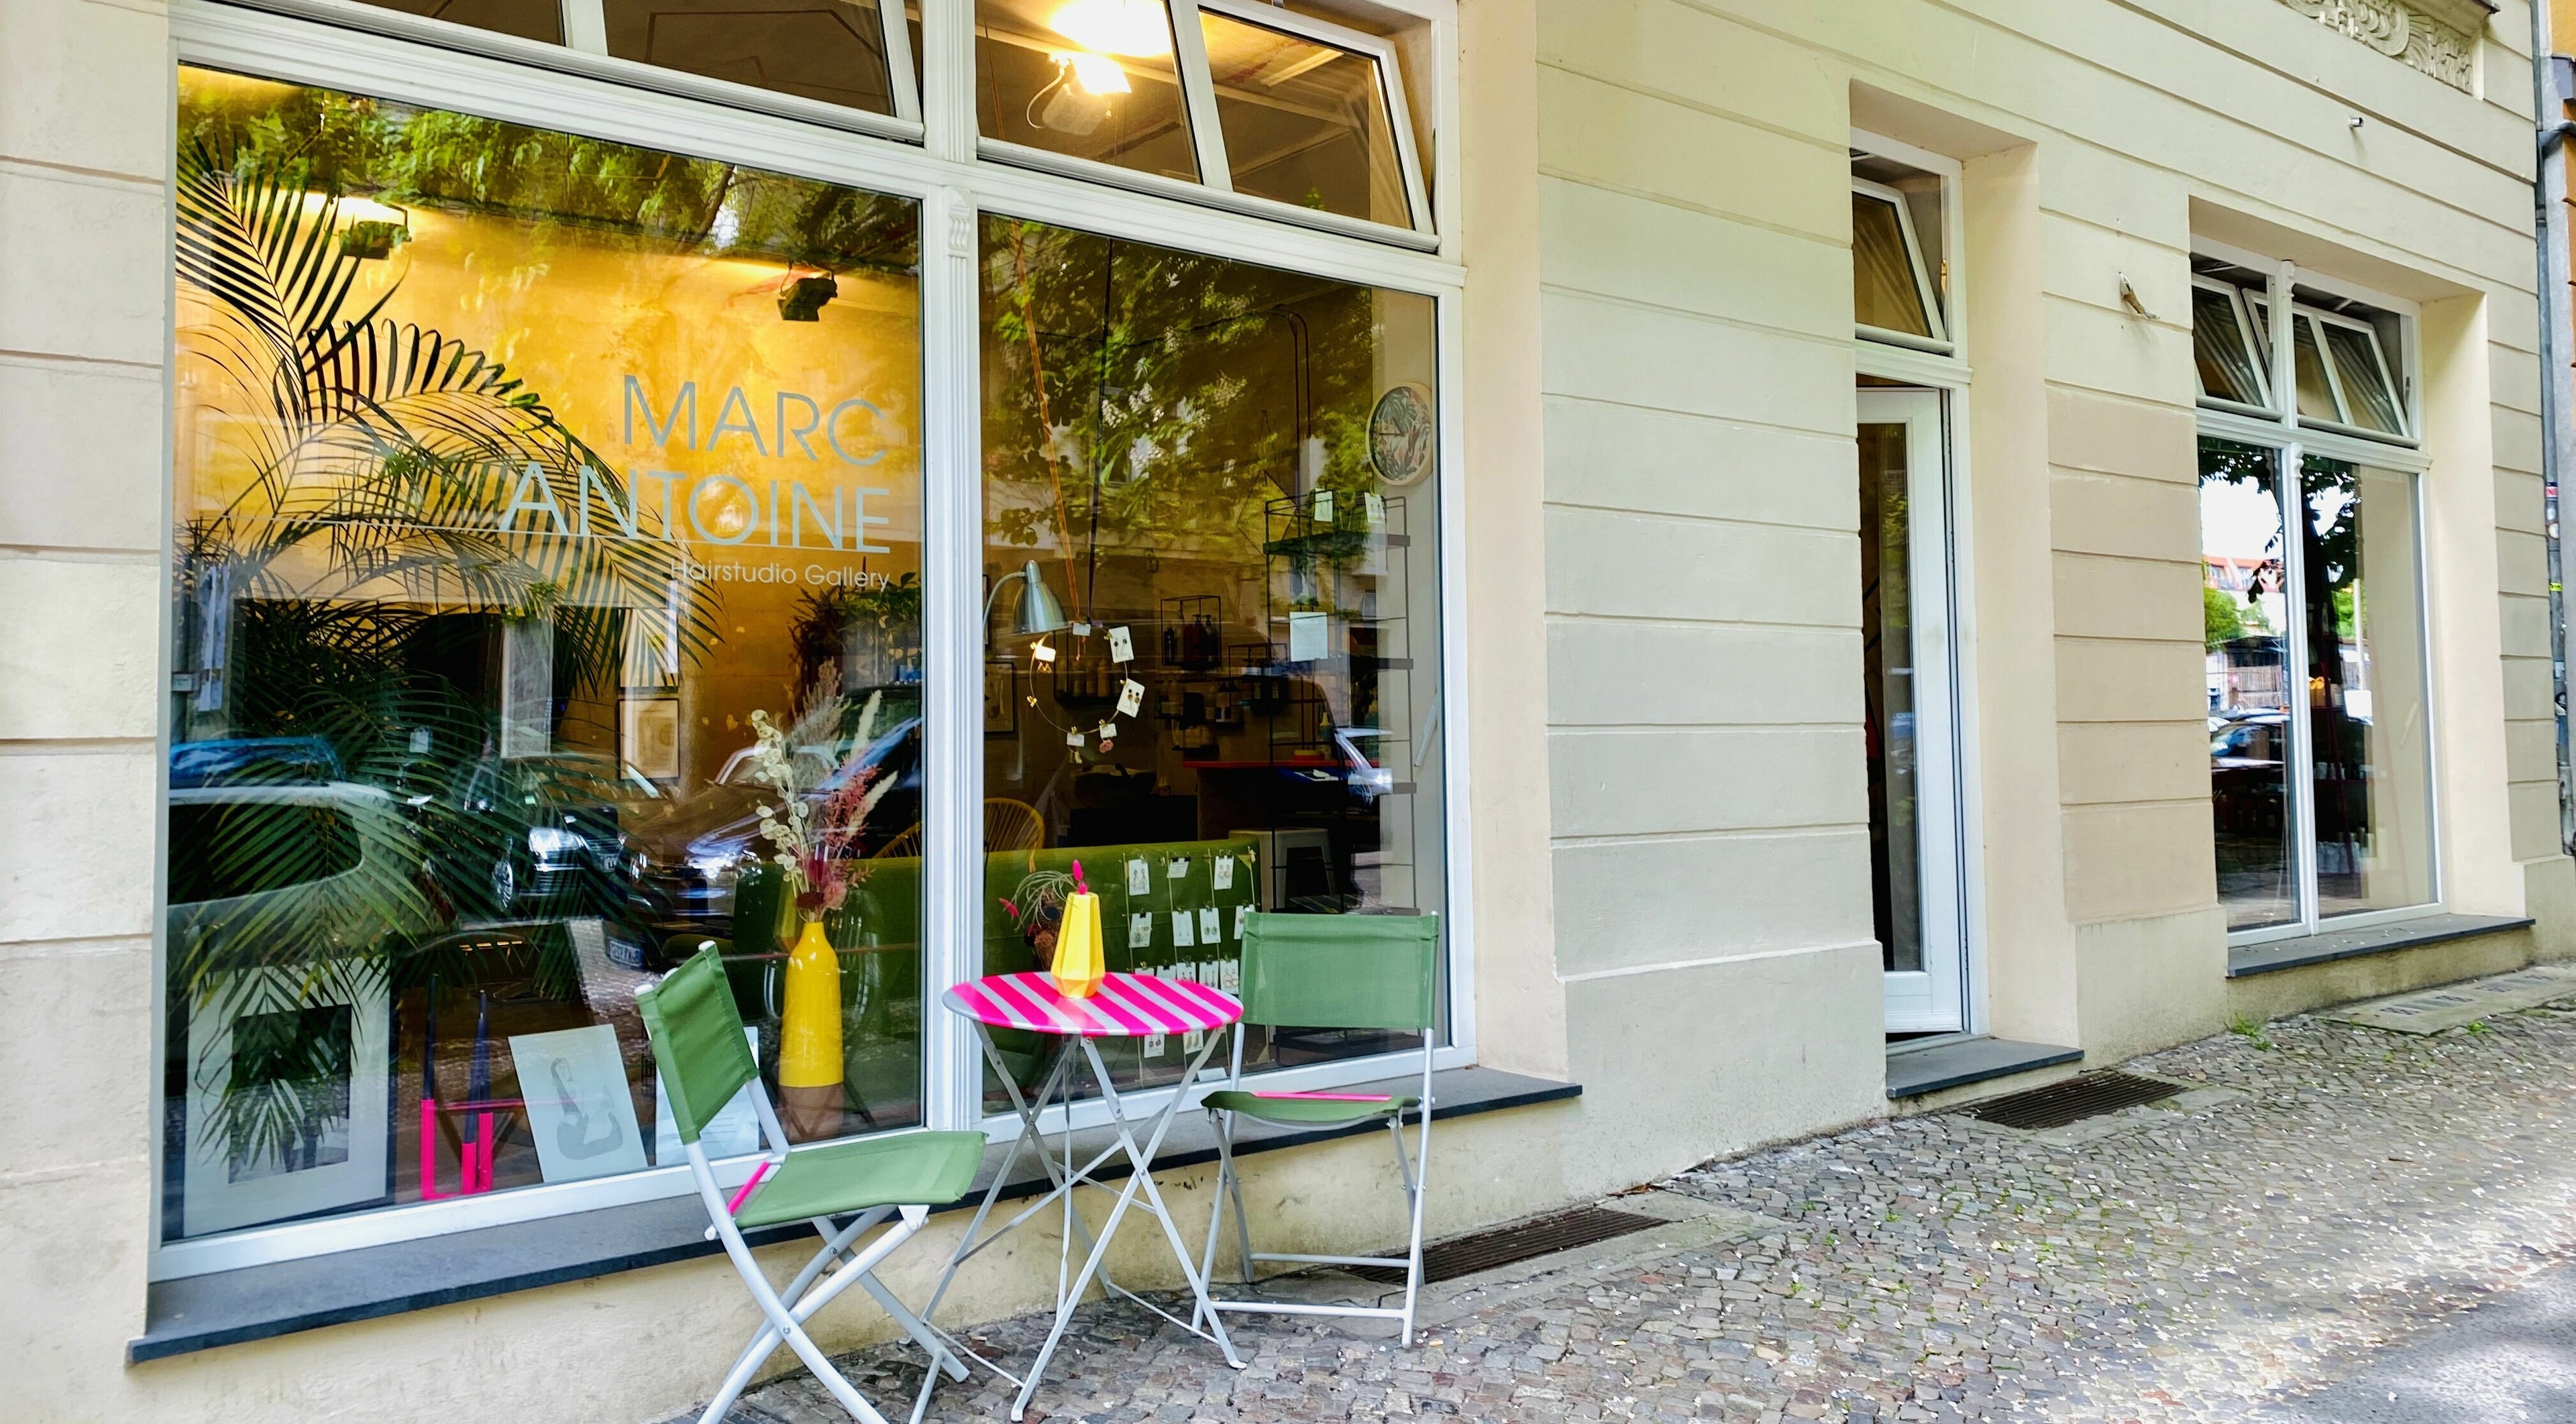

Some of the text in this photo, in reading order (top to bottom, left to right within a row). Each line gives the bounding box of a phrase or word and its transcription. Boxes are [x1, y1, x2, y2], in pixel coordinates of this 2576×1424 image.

[624, 374, 886, 467] MARC
[498, 460, 891, 553] ANTOINE
[671, 559, 890, 592] Hairstudio Gallery
